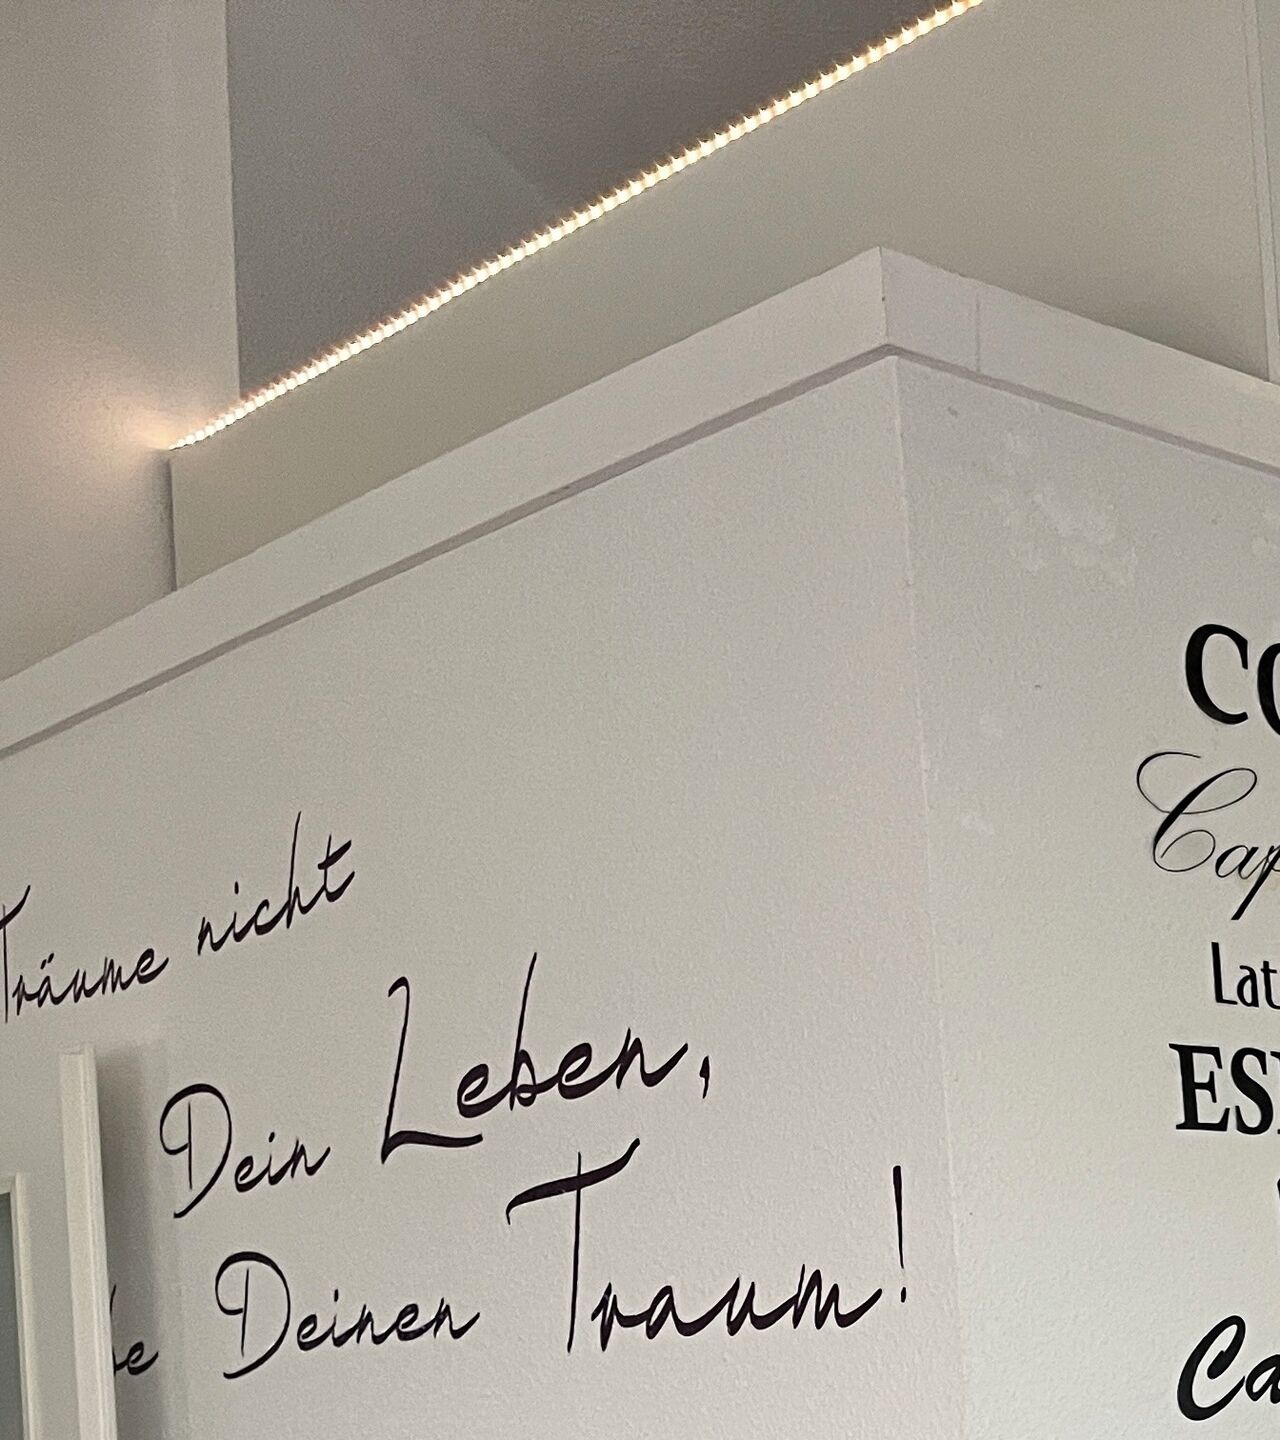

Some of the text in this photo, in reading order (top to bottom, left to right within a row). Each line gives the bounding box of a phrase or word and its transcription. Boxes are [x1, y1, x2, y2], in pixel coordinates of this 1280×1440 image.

[0, 811, 356, 1023] Träume nicht
[160, 952, 710, 1219] Dein Leben,
[215, 1251, 481, 1380] Deinen
[506, 1138, 907, 1353] Traum!
